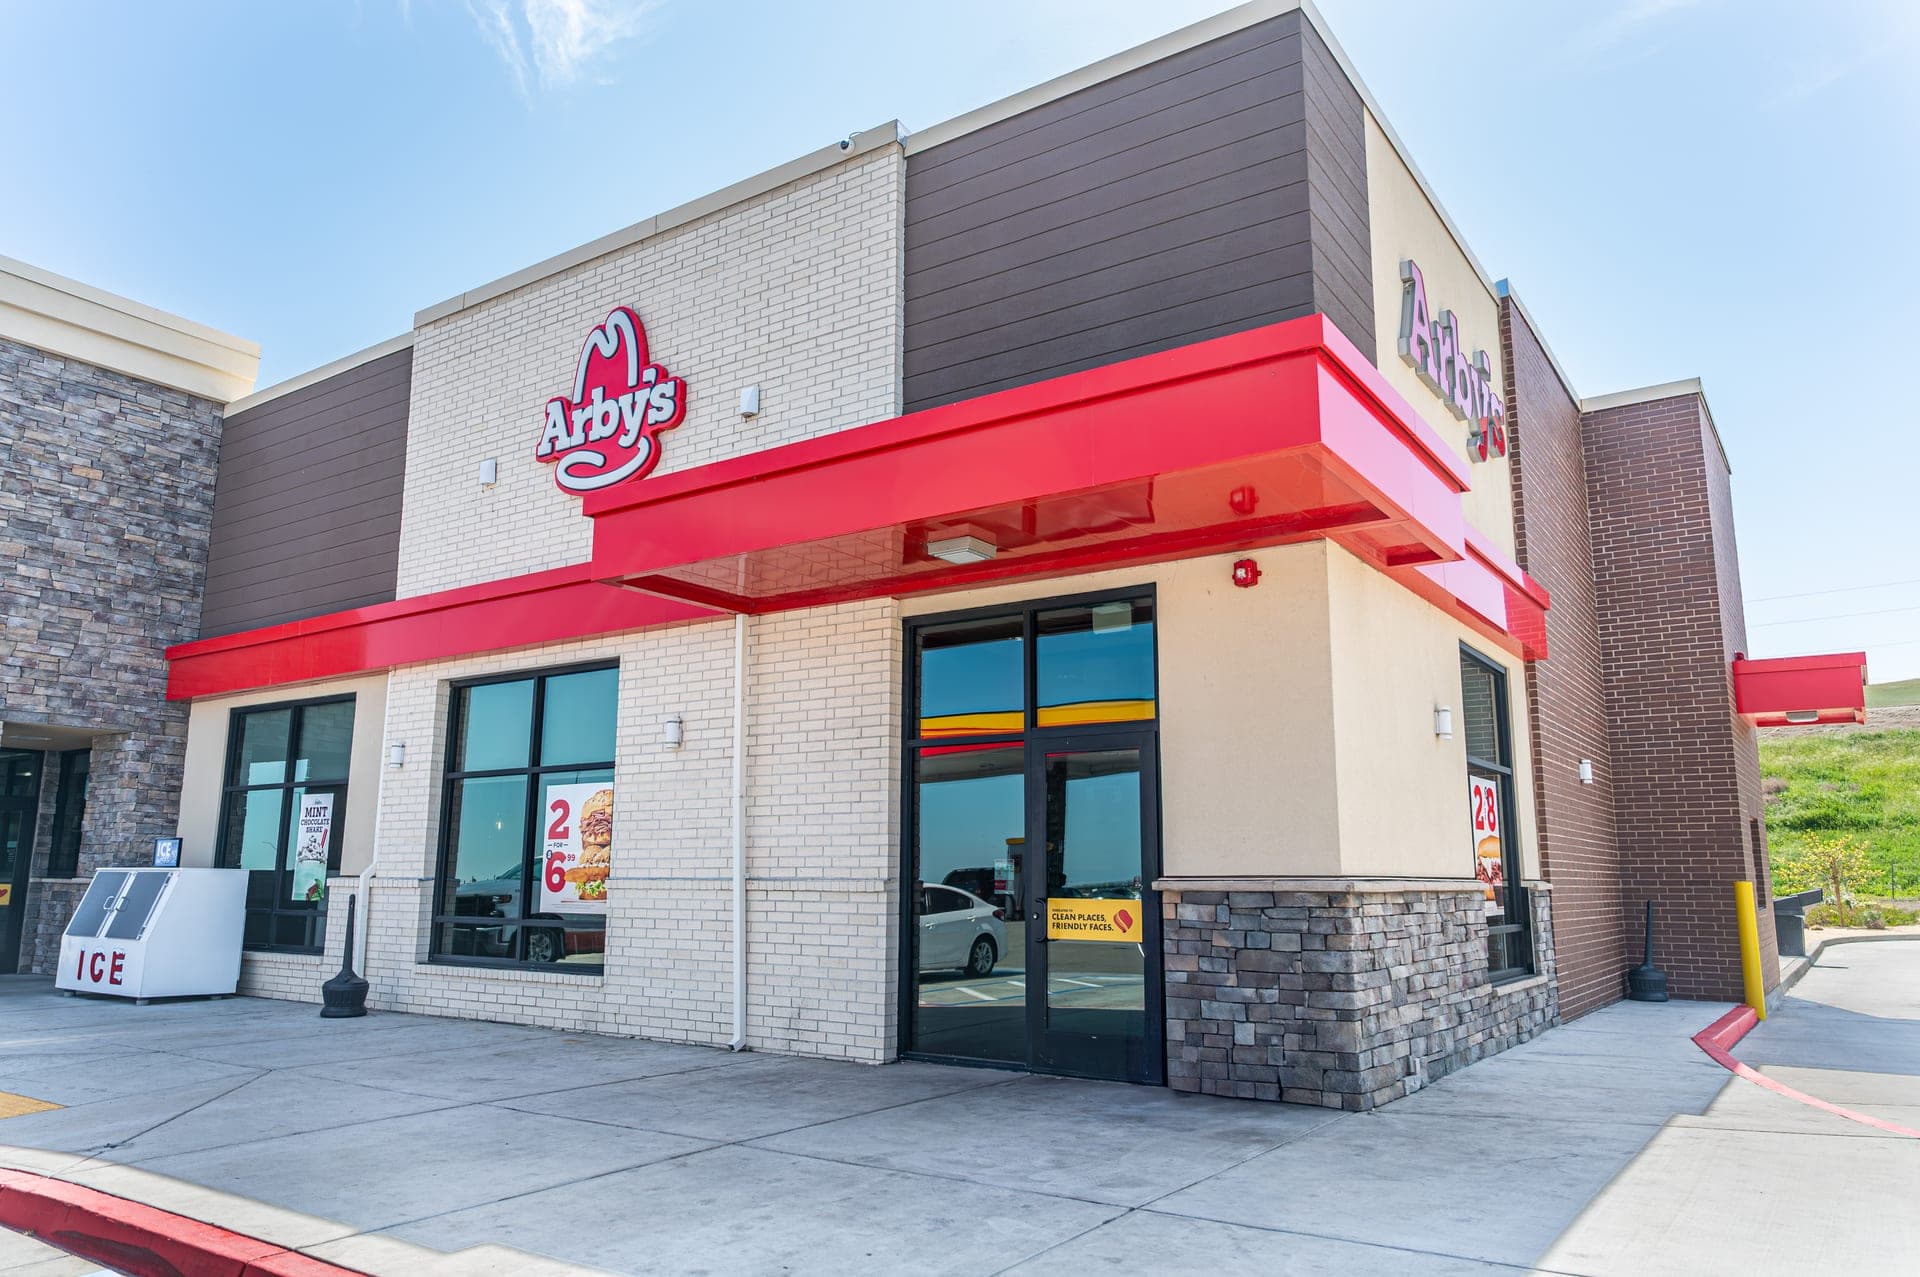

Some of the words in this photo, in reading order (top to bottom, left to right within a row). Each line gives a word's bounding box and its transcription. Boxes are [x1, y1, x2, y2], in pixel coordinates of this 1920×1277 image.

[1400, 259, 1506, 463] Arby's
[537, 367, 677, 457] Arby's
[304, 806, 329, 818] MINT
[548, 799, 570, 840] 2
[1473, 784, 1484, 831] 2
[300, 818, 330, 826] CHOCOLATE
[157, 842, 172, 857] ICE
[1051, 913, 1076, 921] CLEAN
[1078, 914, 1107, 922] PLACES,
[1051, 922, 1088, 930] FRIENDLY
[1089, 923, 1114, 931] FACES.
[77, 948, 126, 986] ICE
